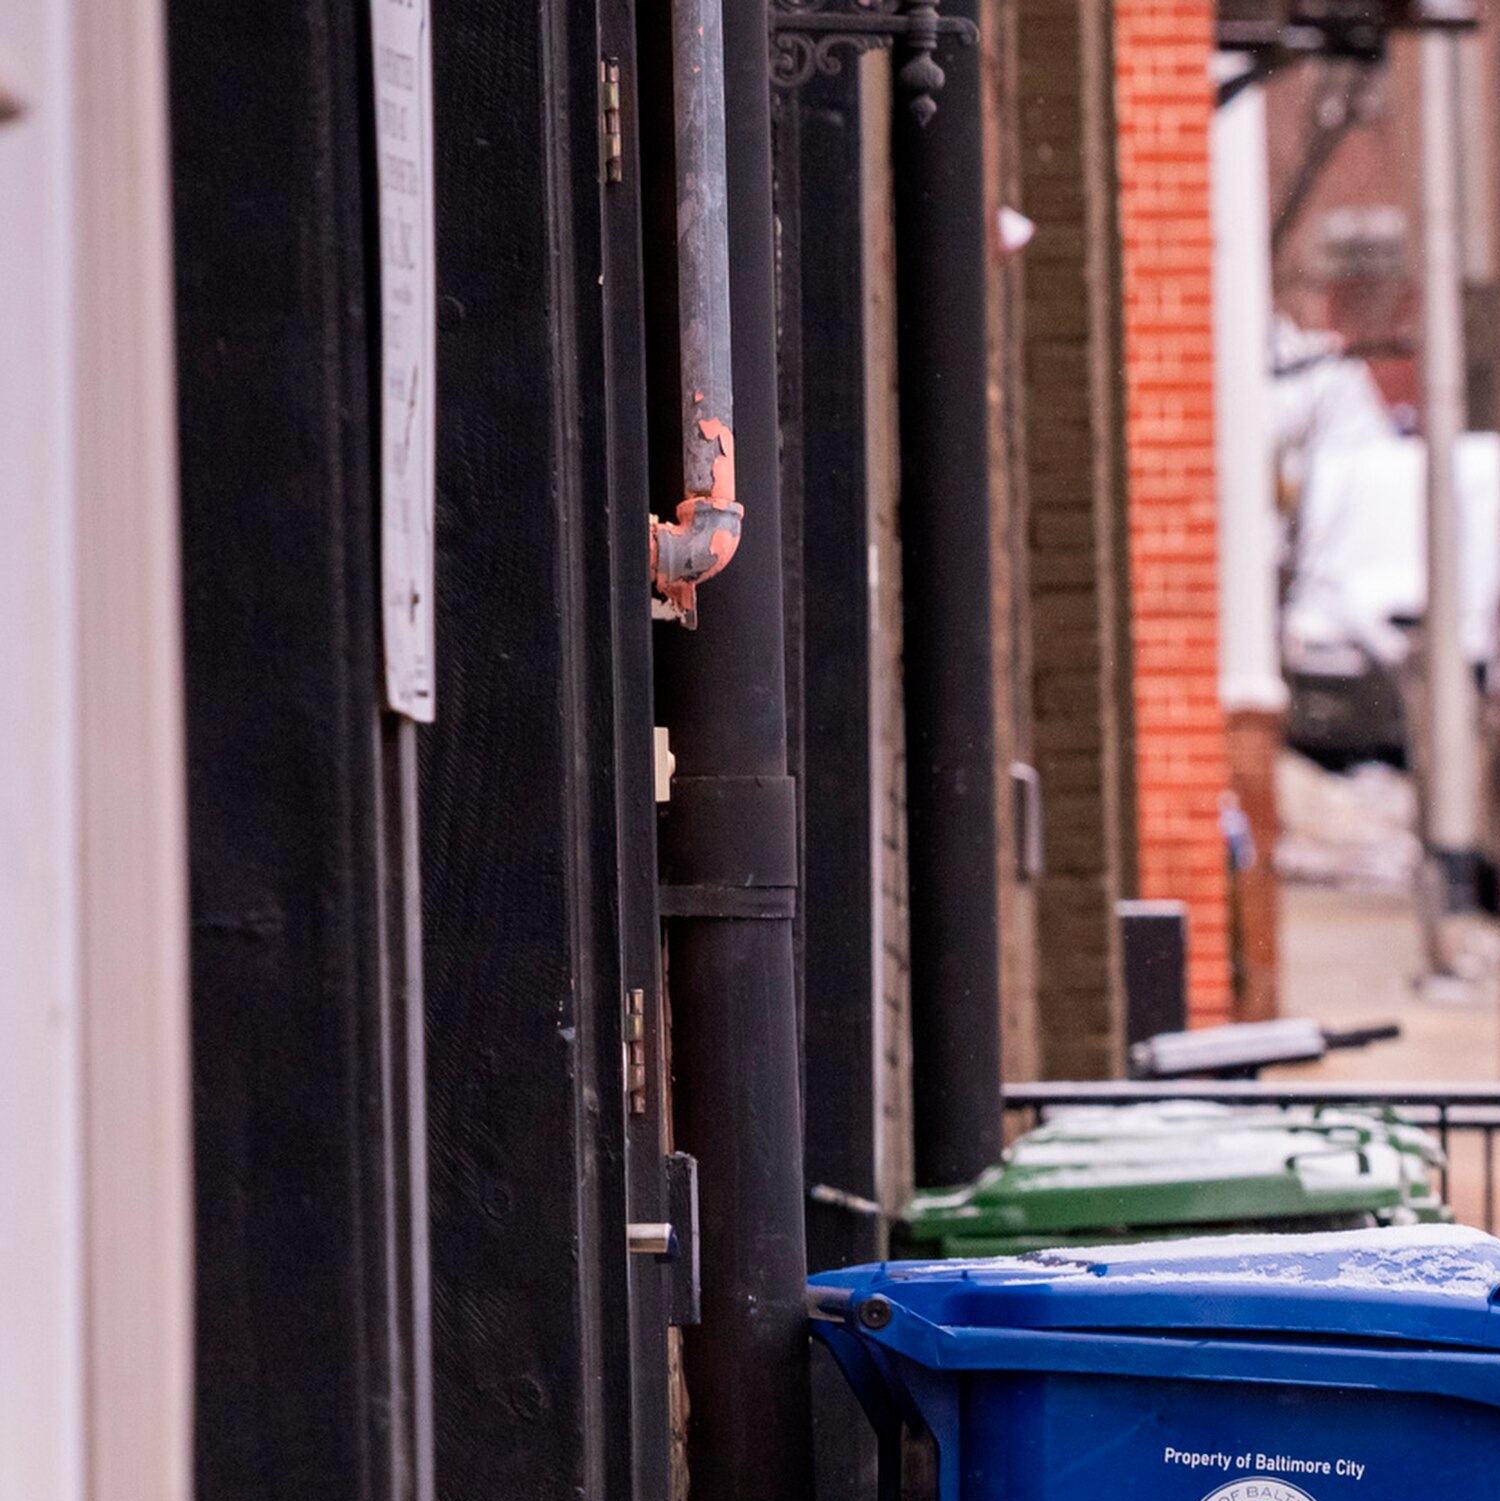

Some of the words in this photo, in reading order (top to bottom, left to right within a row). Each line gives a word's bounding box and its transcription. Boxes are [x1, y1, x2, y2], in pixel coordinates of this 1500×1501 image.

[1163, 1446, 1232, 1472] Property
[1235, 1453, 1252, 1469] of
[1255, 1453, 1332, 1476] Baltimore
[1335, 1458, 1366, 1480] City
